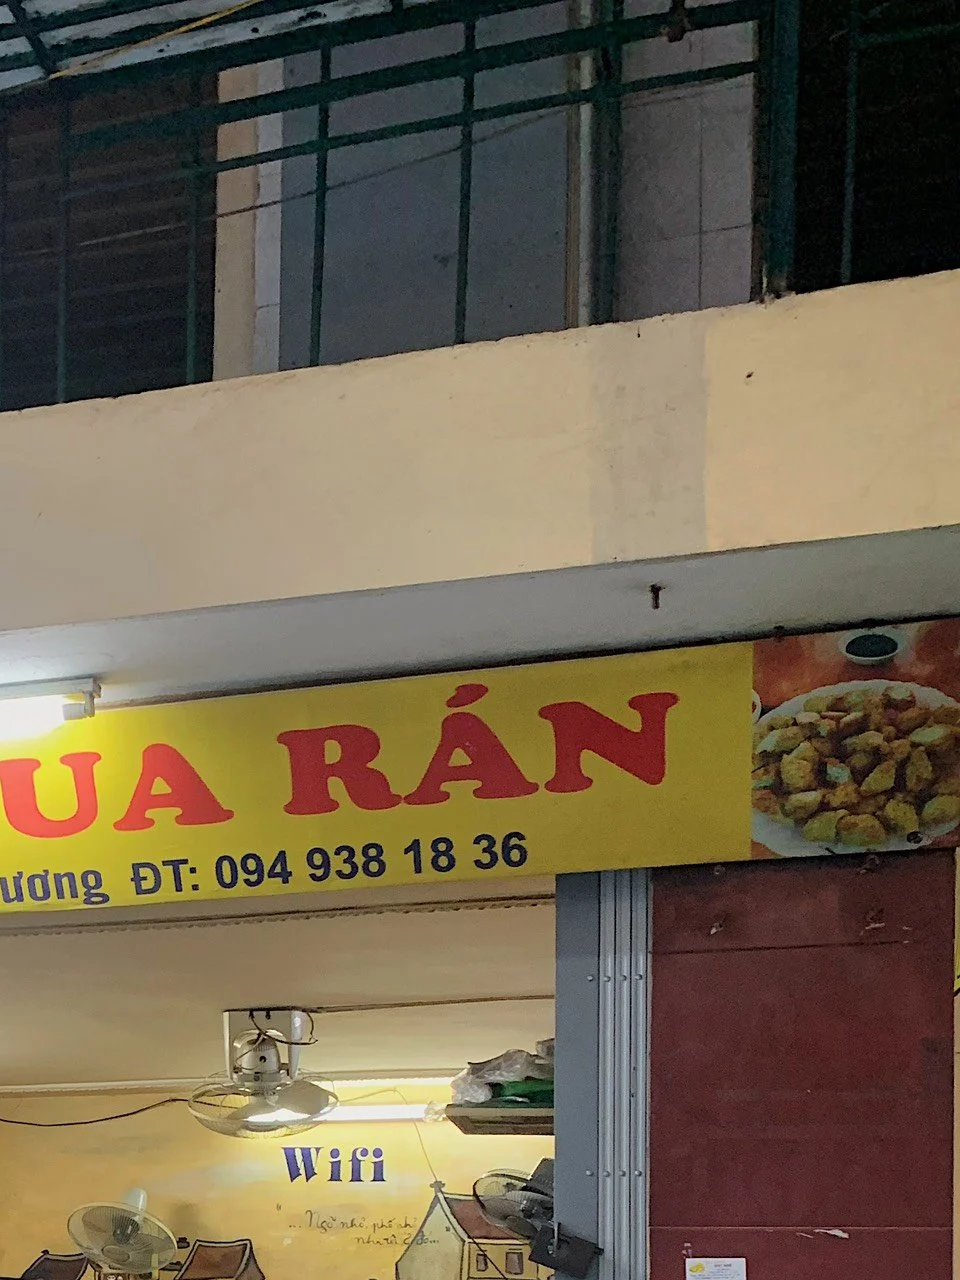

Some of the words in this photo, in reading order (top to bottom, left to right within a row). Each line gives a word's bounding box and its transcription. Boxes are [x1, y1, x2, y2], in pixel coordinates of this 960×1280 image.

[277, 683, 678, 816] RÁN
[131, 858, 200, 896] ĐT:
[214, 852, 293, 890] 094
[305, 843, 387, 882] 938
[411, 837, 458, 875] 18
[472, 831, 529, 870] 36
[281, 1146, 386, 1183] Wifi
